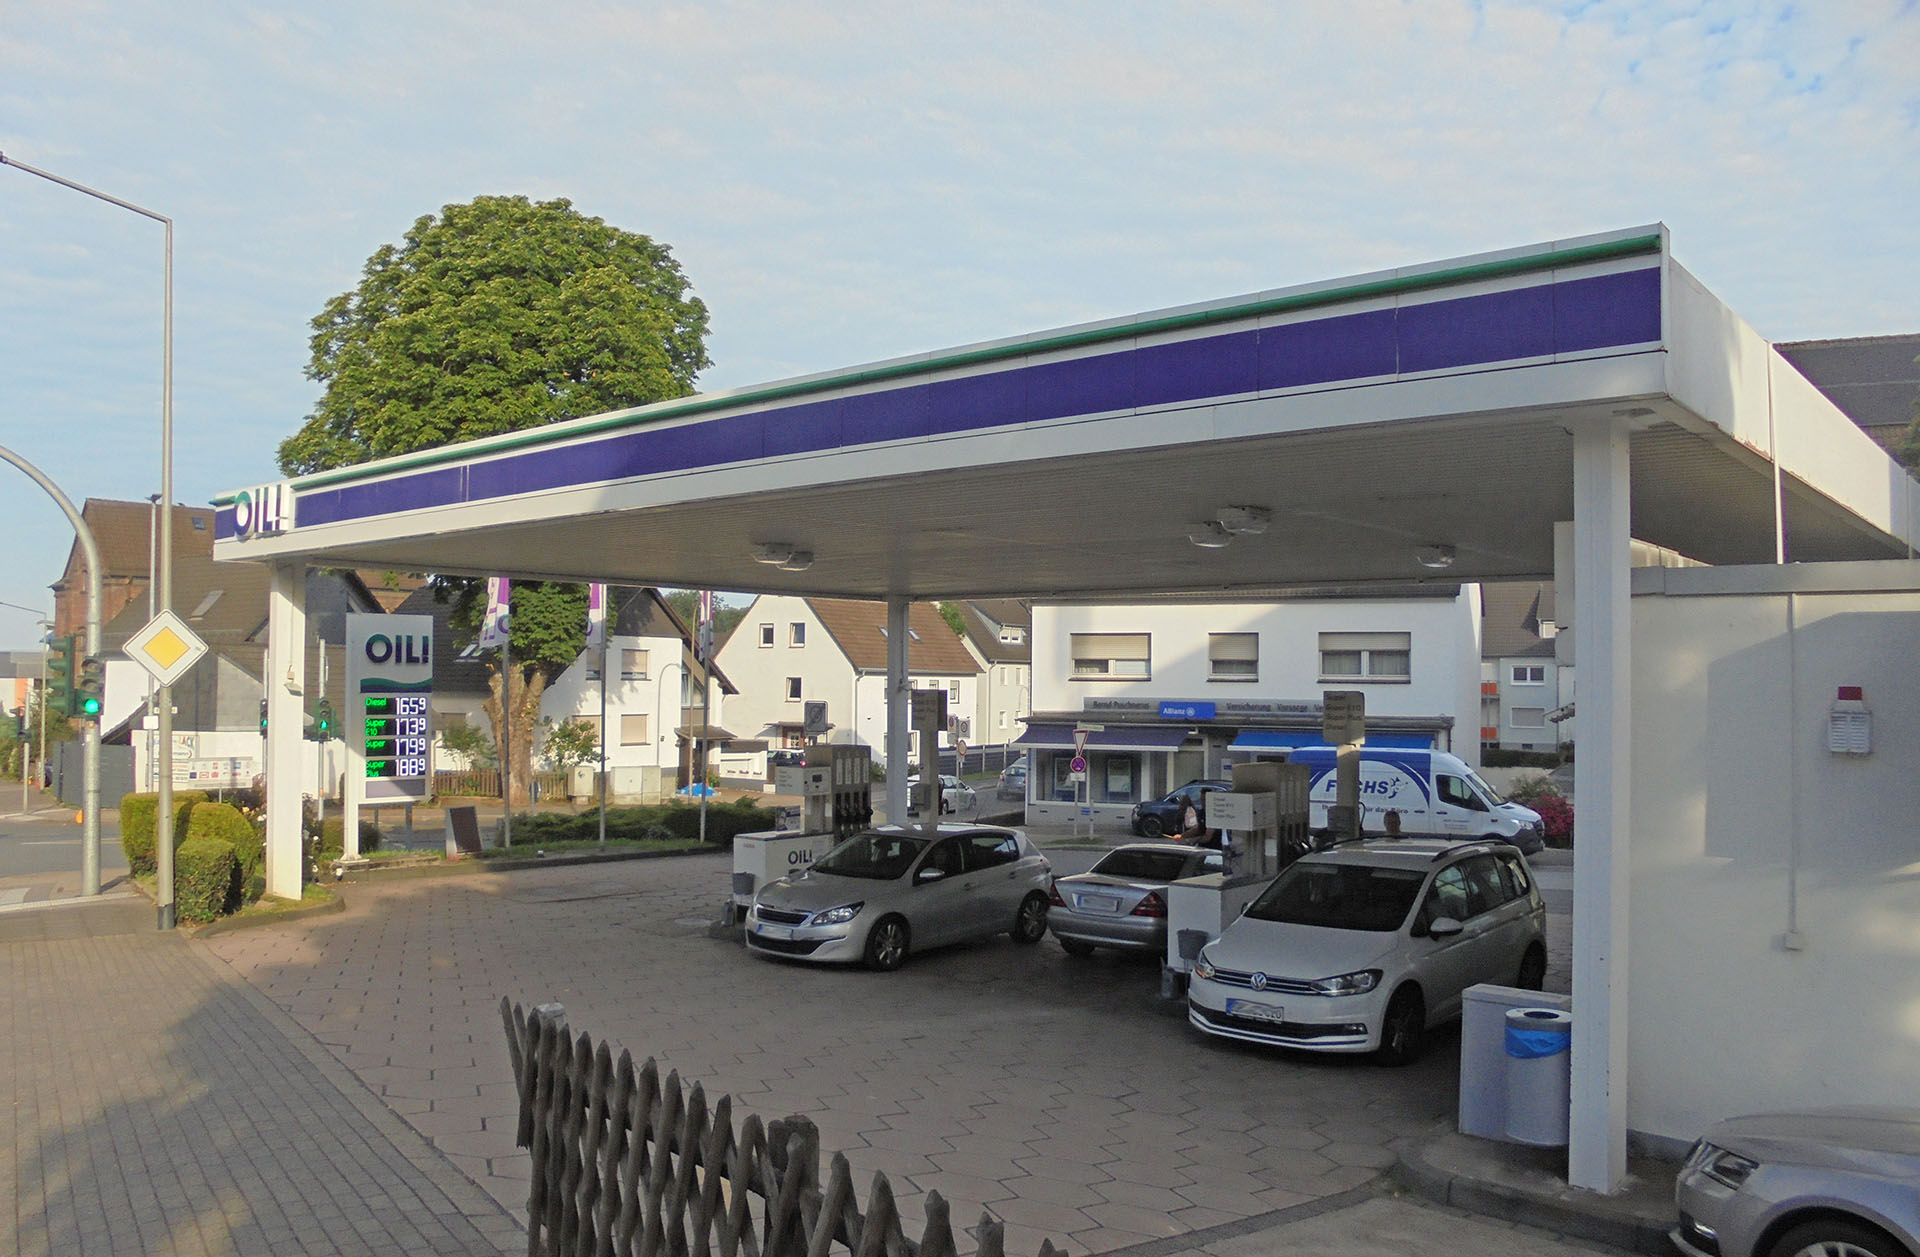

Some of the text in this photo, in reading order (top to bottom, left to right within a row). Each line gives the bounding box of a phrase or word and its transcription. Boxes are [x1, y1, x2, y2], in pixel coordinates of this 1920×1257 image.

[234, 484, 283, 536] OIL!
[365, 633, 430, 664] OIL!
[365, 697, 426, 715] Diesel 1659
[1163, 707, 1185, 715] Allianz
[1226, 702, 1271, 712] Versicherung
[365, 717, 426, 736] Super 1739
[365, 728, 378, 736] E10
[365, 738, 426, 756] Super 1799
[365, 758, 426, 776] Super 1889
[1326, 779, 1389, 795] FHS
[788, 849, 813, 865] OIL!
